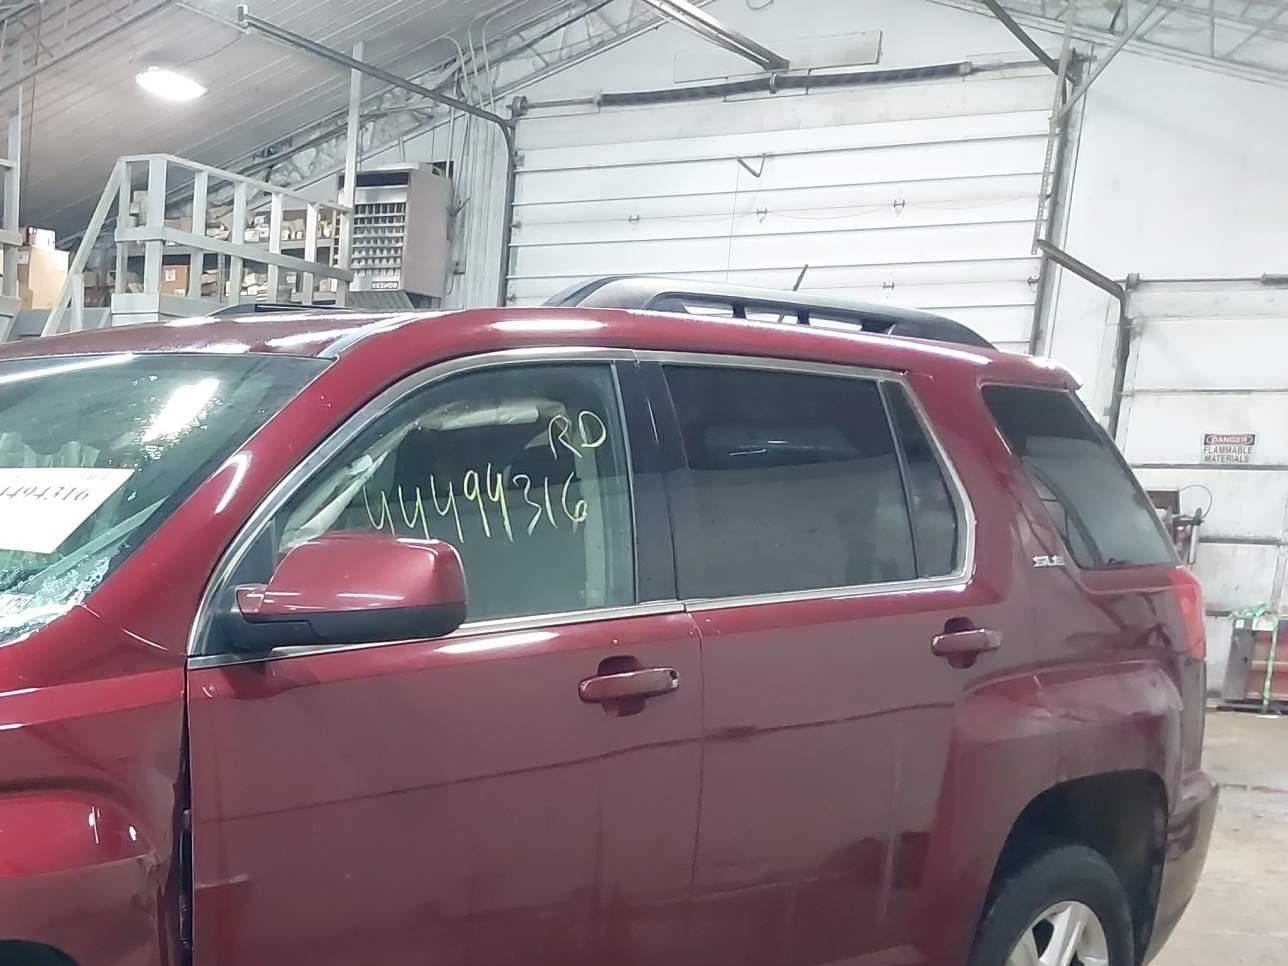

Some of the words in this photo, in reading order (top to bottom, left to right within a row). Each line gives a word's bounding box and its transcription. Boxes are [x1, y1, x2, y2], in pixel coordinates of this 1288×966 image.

[548, 411, 606, 459] RD
[1211, 435, 1247, 444] DANGER
[1203, 446, 1253, 454] FLAMMABLE
[1204, 454, 1249, 463] MATERIALS
[363, 462, 587, 543] 44494316
